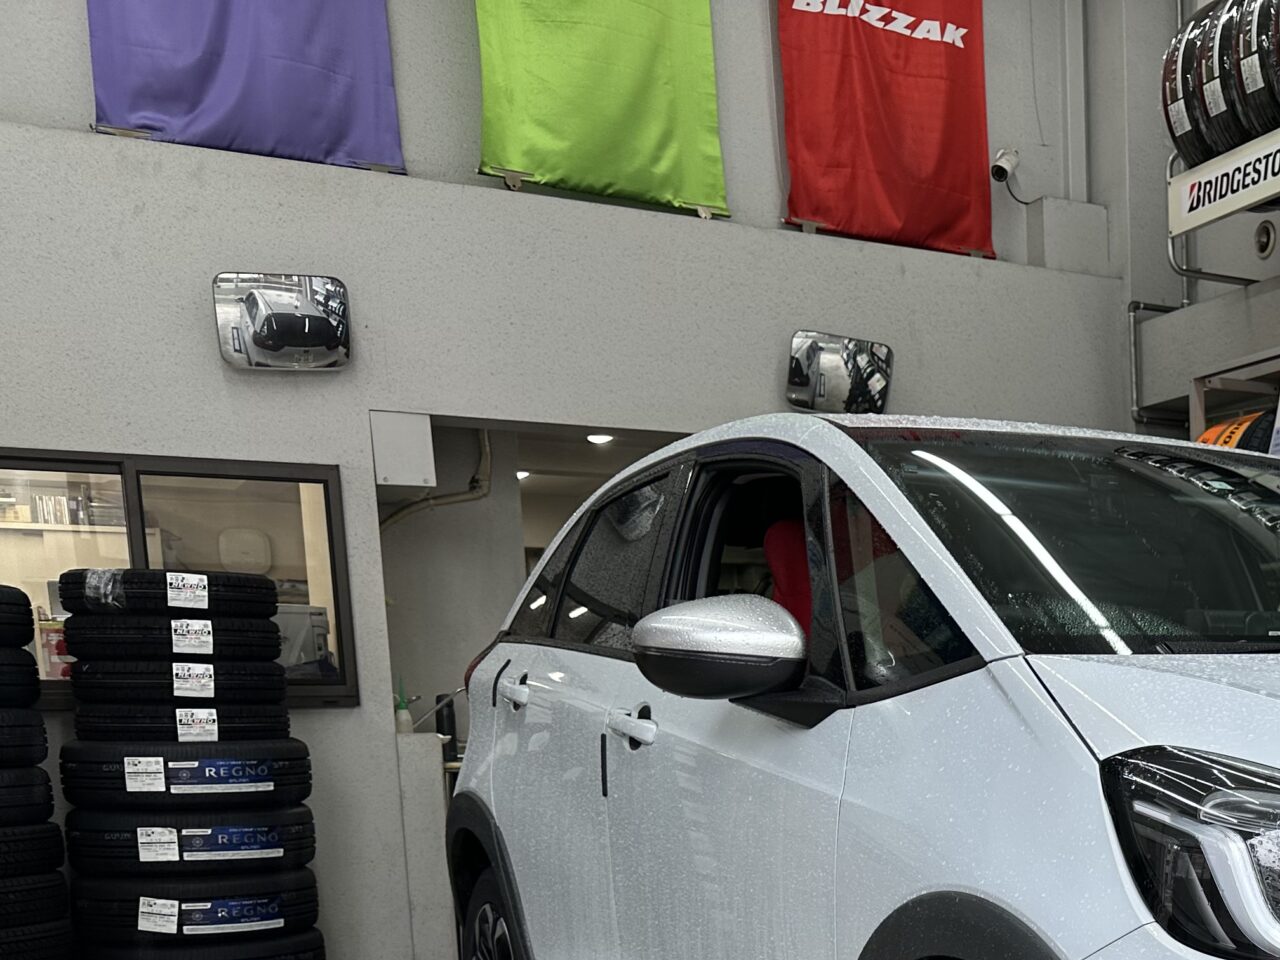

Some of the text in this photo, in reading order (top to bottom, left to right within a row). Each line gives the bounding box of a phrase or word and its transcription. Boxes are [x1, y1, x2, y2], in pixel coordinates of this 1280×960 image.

[792, 0, 968, 48] BLIZZAK
[205, 765, 268, 778] REGNO
[217, 832, 279, 845] REGNO
[217, 903, 279, 917] REGNO
